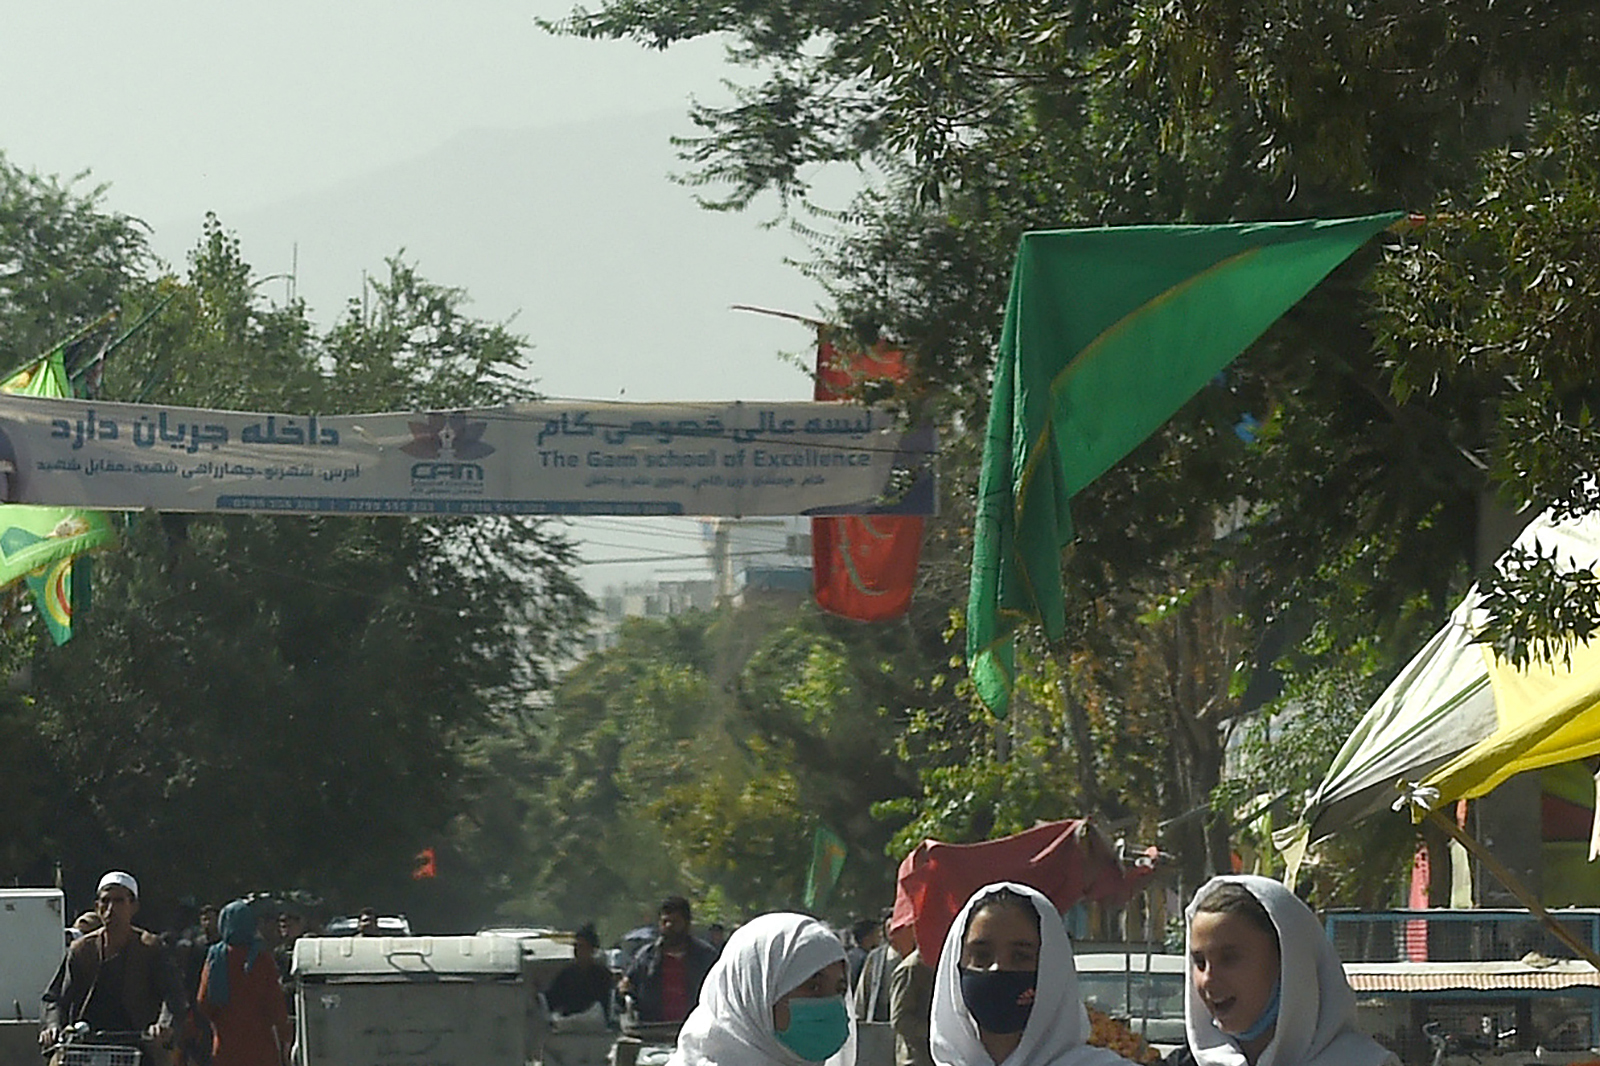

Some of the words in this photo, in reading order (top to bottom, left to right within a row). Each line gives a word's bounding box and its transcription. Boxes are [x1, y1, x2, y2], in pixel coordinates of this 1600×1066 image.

[51, 409, 120, 450] دارد
[133, 411, 229, 453] جریان
[240, 415, 340, 446] داخله
[538, 450, 580, 468] The
[587, 450, 638, 468] Gam
[644, 448, 717, 468] school
[724, 449, 747, 467] of
[754, 449, 871, 468] Excellence
